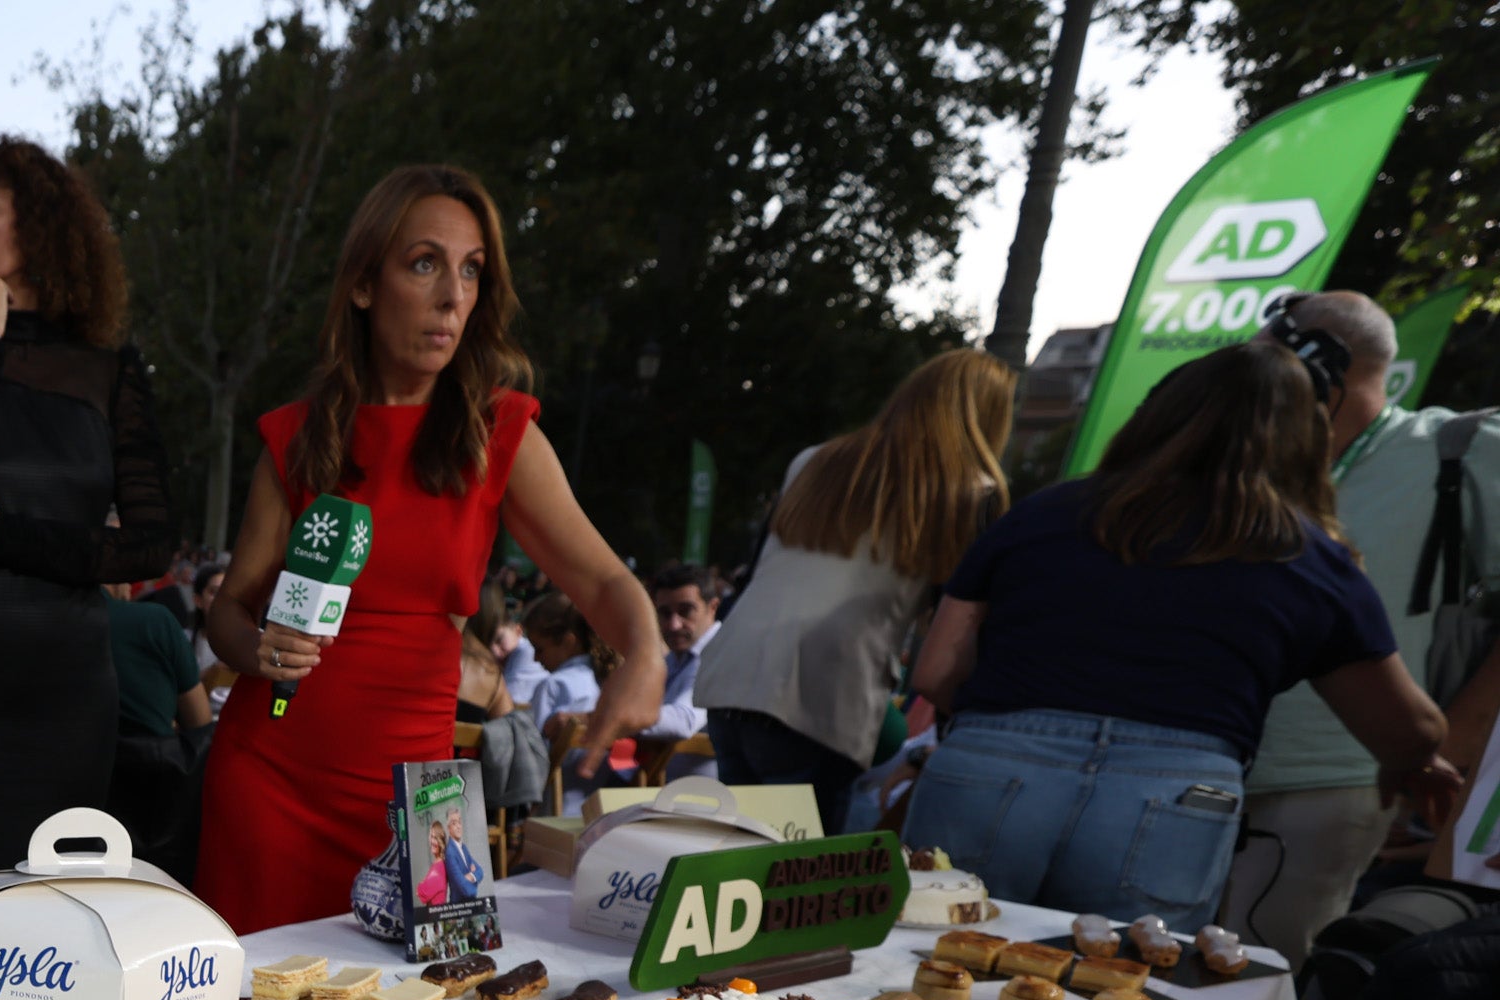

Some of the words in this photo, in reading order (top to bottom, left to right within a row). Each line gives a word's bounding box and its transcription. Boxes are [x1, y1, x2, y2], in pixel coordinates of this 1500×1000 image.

[1195, 218, 1297, 264] AD
[322, 604, 339, 620] AD
[660, 878, 763, 964] AD
[763, 882, 894, 933] DIRECTO
